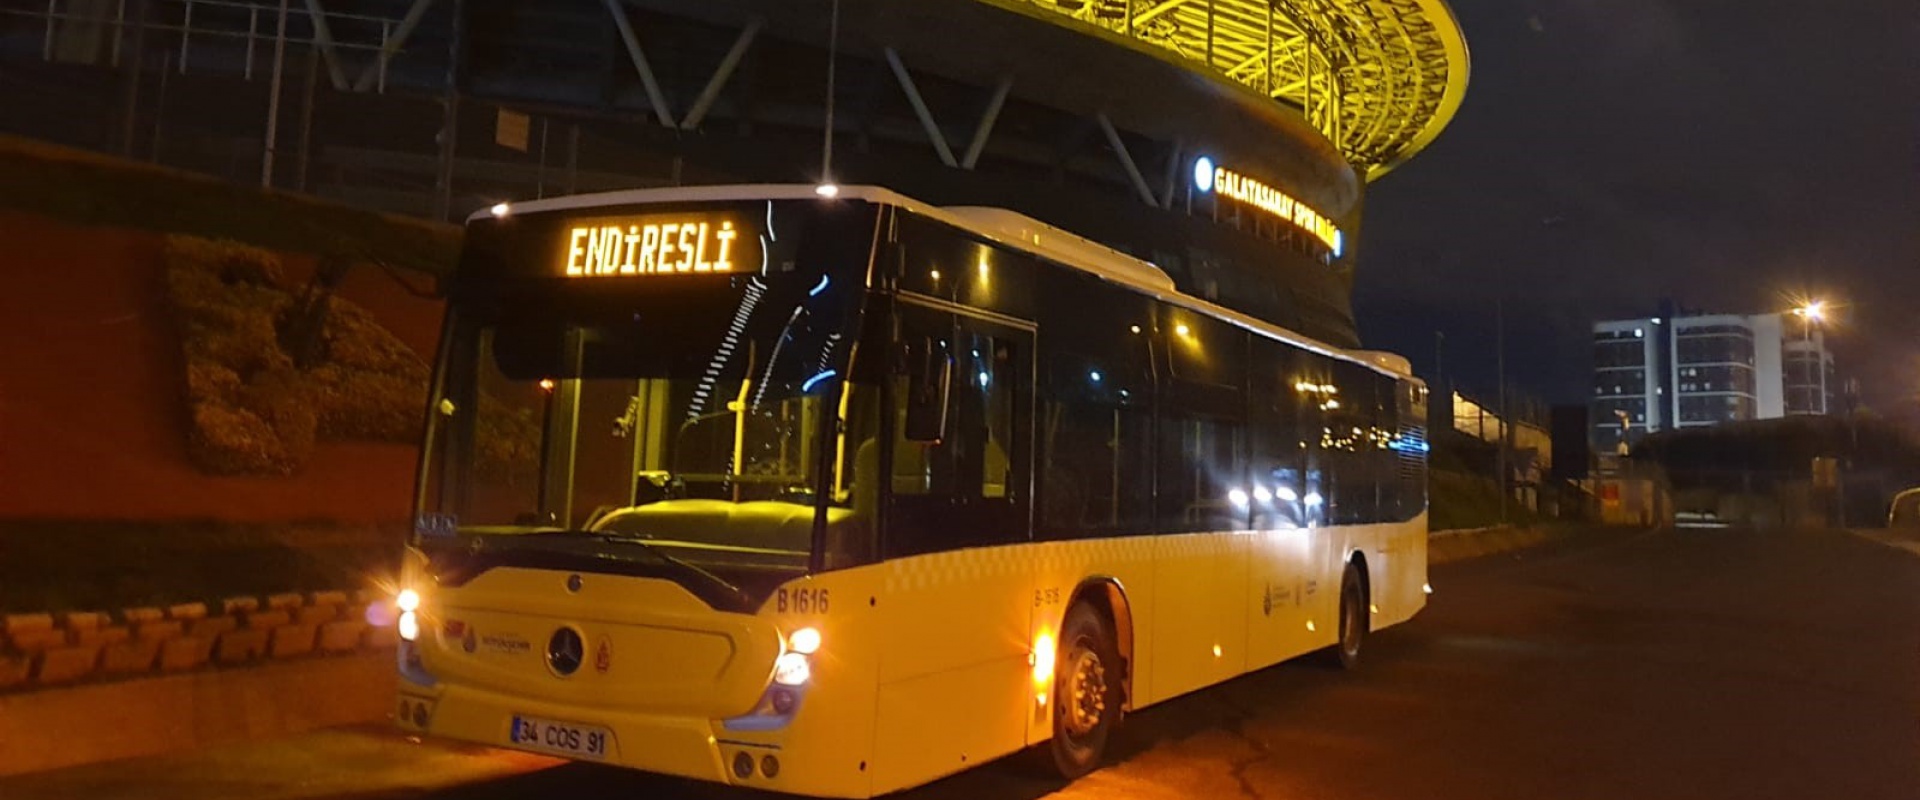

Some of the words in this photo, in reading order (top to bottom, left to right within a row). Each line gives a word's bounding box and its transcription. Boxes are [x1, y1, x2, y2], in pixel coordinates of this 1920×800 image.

[1214, 167, 1294, 221] GALATASARAY
[566, 221, 736, 275] ENDİRESLİ
[778, 588, 788, 613] B
[791, 588, 829, 614] 1616
[520, 721, 538, 741] 34
[546, 726, 580, 750] COS
[587, 732, 604, 755] 91
